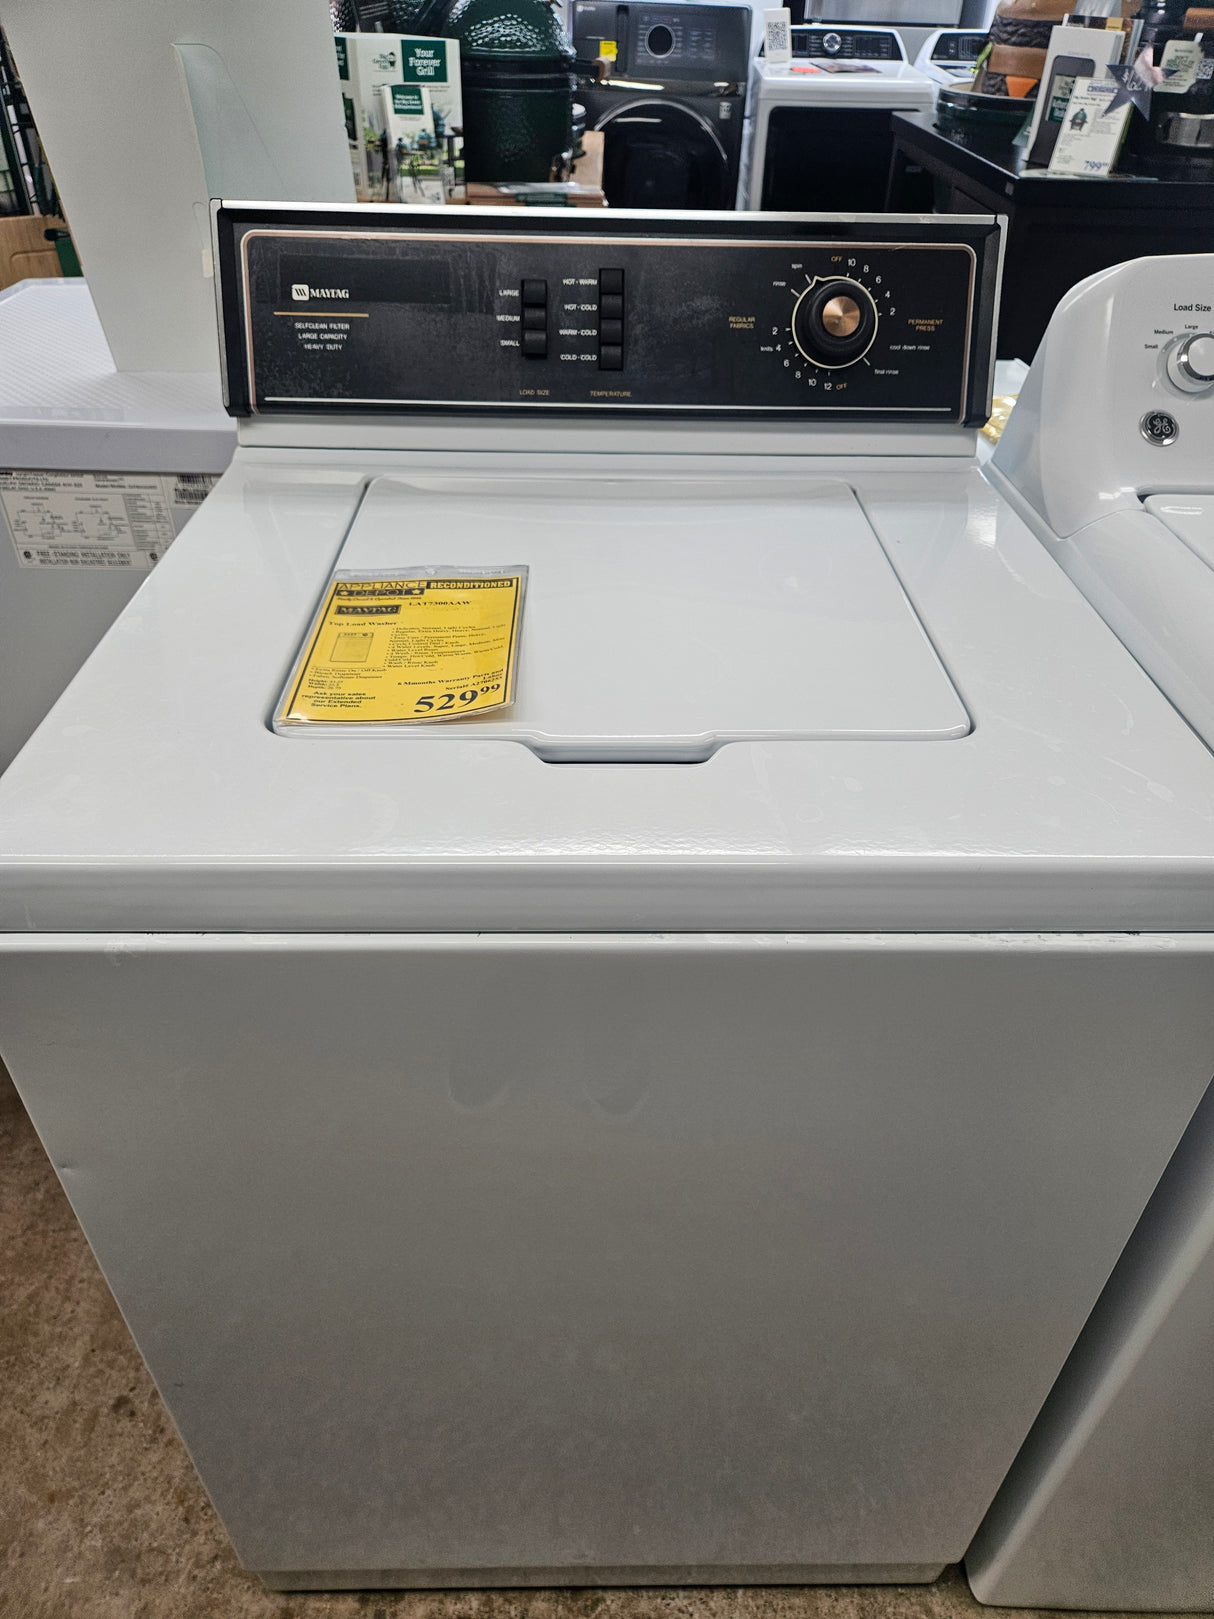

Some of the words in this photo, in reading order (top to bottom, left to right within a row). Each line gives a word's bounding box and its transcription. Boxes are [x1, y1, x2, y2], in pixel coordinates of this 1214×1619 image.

[414, 47, 434, 58] Your
[408, 57, 441, 67] Forever
[416, 66, 435, 76] Grill
[847, 258, 857, 267] 10
[862, 264, 870, 273] 8
[875, 275, 882, 284] 6
[309, 288, 350, 299] MAYTAG
[499, 289, 520, 297] LARGE
[884, 290, 891, 299] 4
[889, 307, 896, 316] 2
[1173, 303, 1194, 312] Load
[1194, 303, 1212, 313] Size
[496, 314, 521, 322] MEDIUM
[907, 318, 944, 326] PERMANENT
[295, 322, 328, 330] SELFCLEAN
[329, 323, 351, 331] FILTER
[771, 326, 779, 336] 2
[298, 332, 318, 340] LARGE
[319, 333, 348, 341] CAPACITY
[304, 343, 324, 351] HEAVY
[325, 343, 343, 351] DUTY
[500, 339, 520, 347] SMALL
[775, 344, 782, 352] 4
[783, 359, 790, 368] 6
[794, 371, 802, 379] 8
[808, 378, 817, 387] 10
[824, 382, 833, 391] 12
[835, 382, 848, 390] OFF
[519, 388, 536, 396] LOAD
[536, 388, 551, 396] SIZE
[589, 390, 632, 398] TEMPERATURE
[338, 582, 425, 590] APPLIANCE
[430, 581, 511, 589] RECONDITIONED
[340, 606, 397, 615] MAYTAG
[438, 676, 471, 684] Warranty
[413, 689, 478, 713] 529
[480, 683, 501, 696] 99
